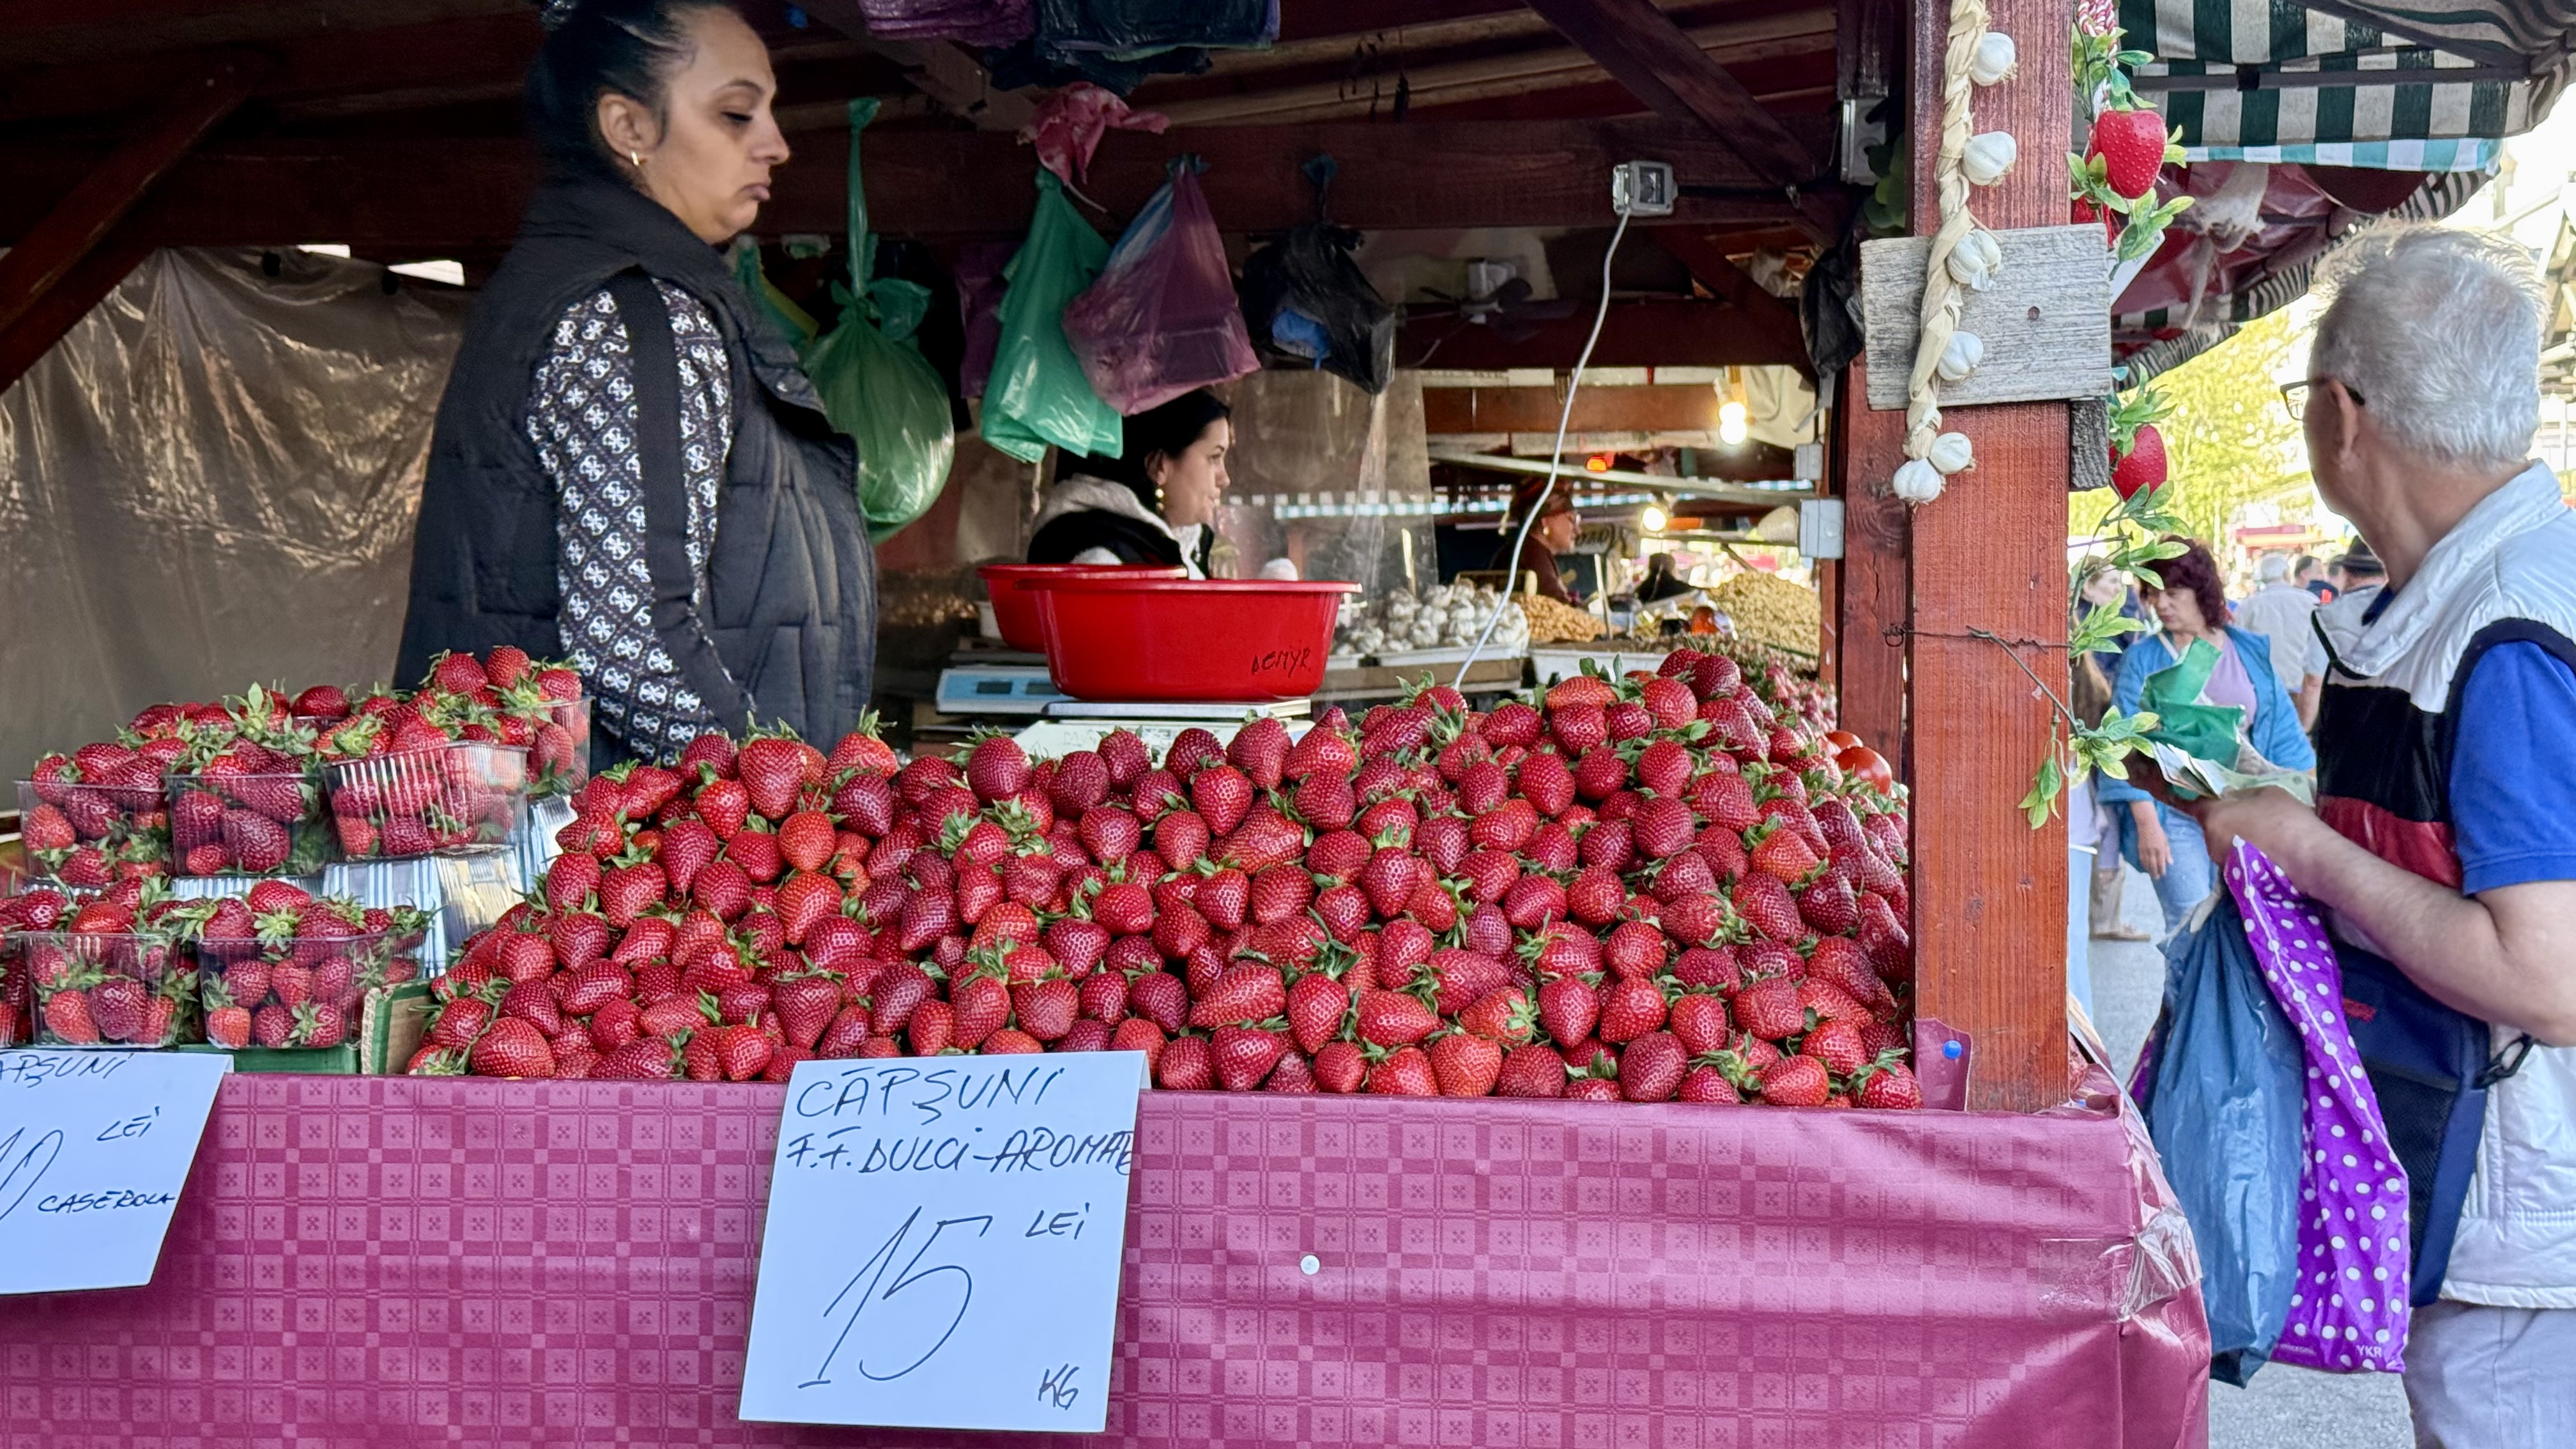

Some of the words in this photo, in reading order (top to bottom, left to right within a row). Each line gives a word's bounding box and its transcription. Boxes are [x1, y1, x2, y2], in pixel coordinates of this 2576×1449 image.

[797, 1205, 993, 1389] 15
[2356, 1344, 2382, 1358] YKR
[1037, 1363, 1080, 1411] KG
